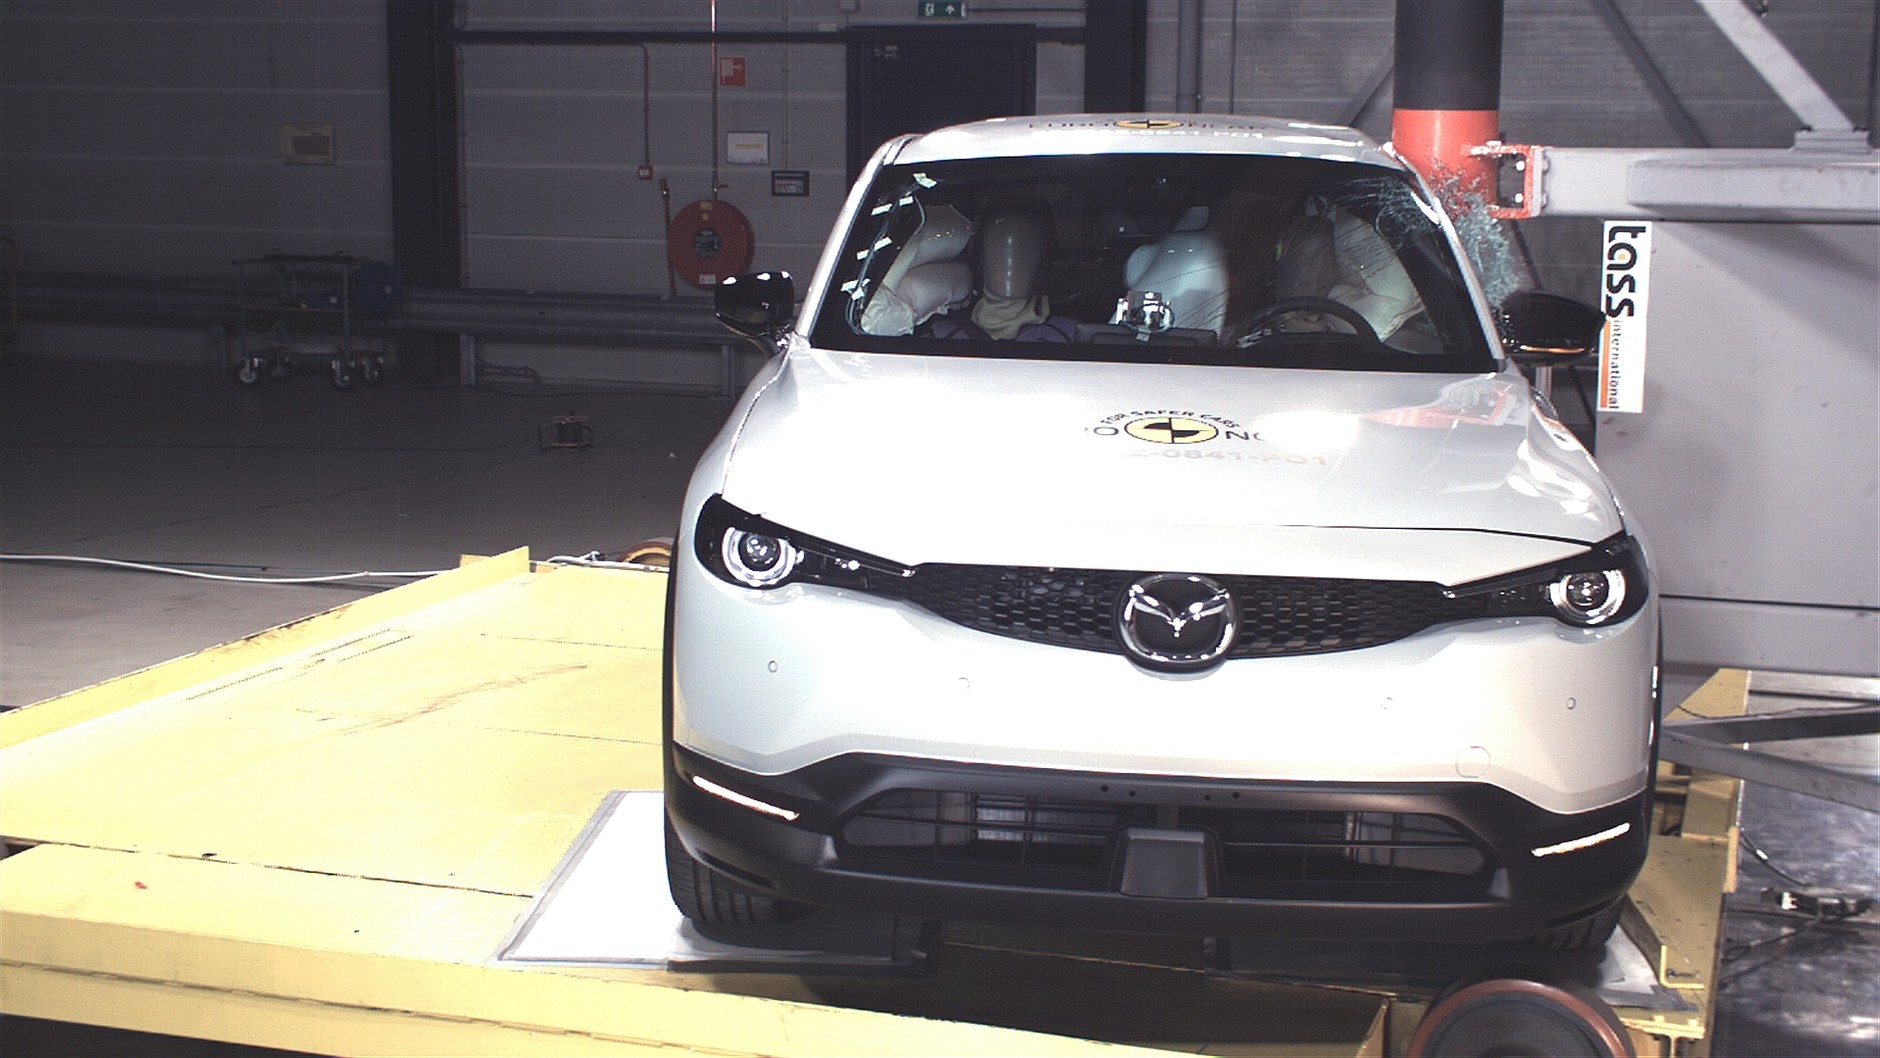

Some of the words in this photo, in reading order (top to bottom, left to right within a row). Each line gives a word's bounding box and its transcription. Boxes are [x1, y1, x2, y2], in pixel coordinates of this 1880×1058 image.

[1605, 225, 1646, 318] tass
[1608, 319, 1624, 409] international
[1130, 409, 1195, 417] SAFER
[1199, 413, 1242, 428] CARS
